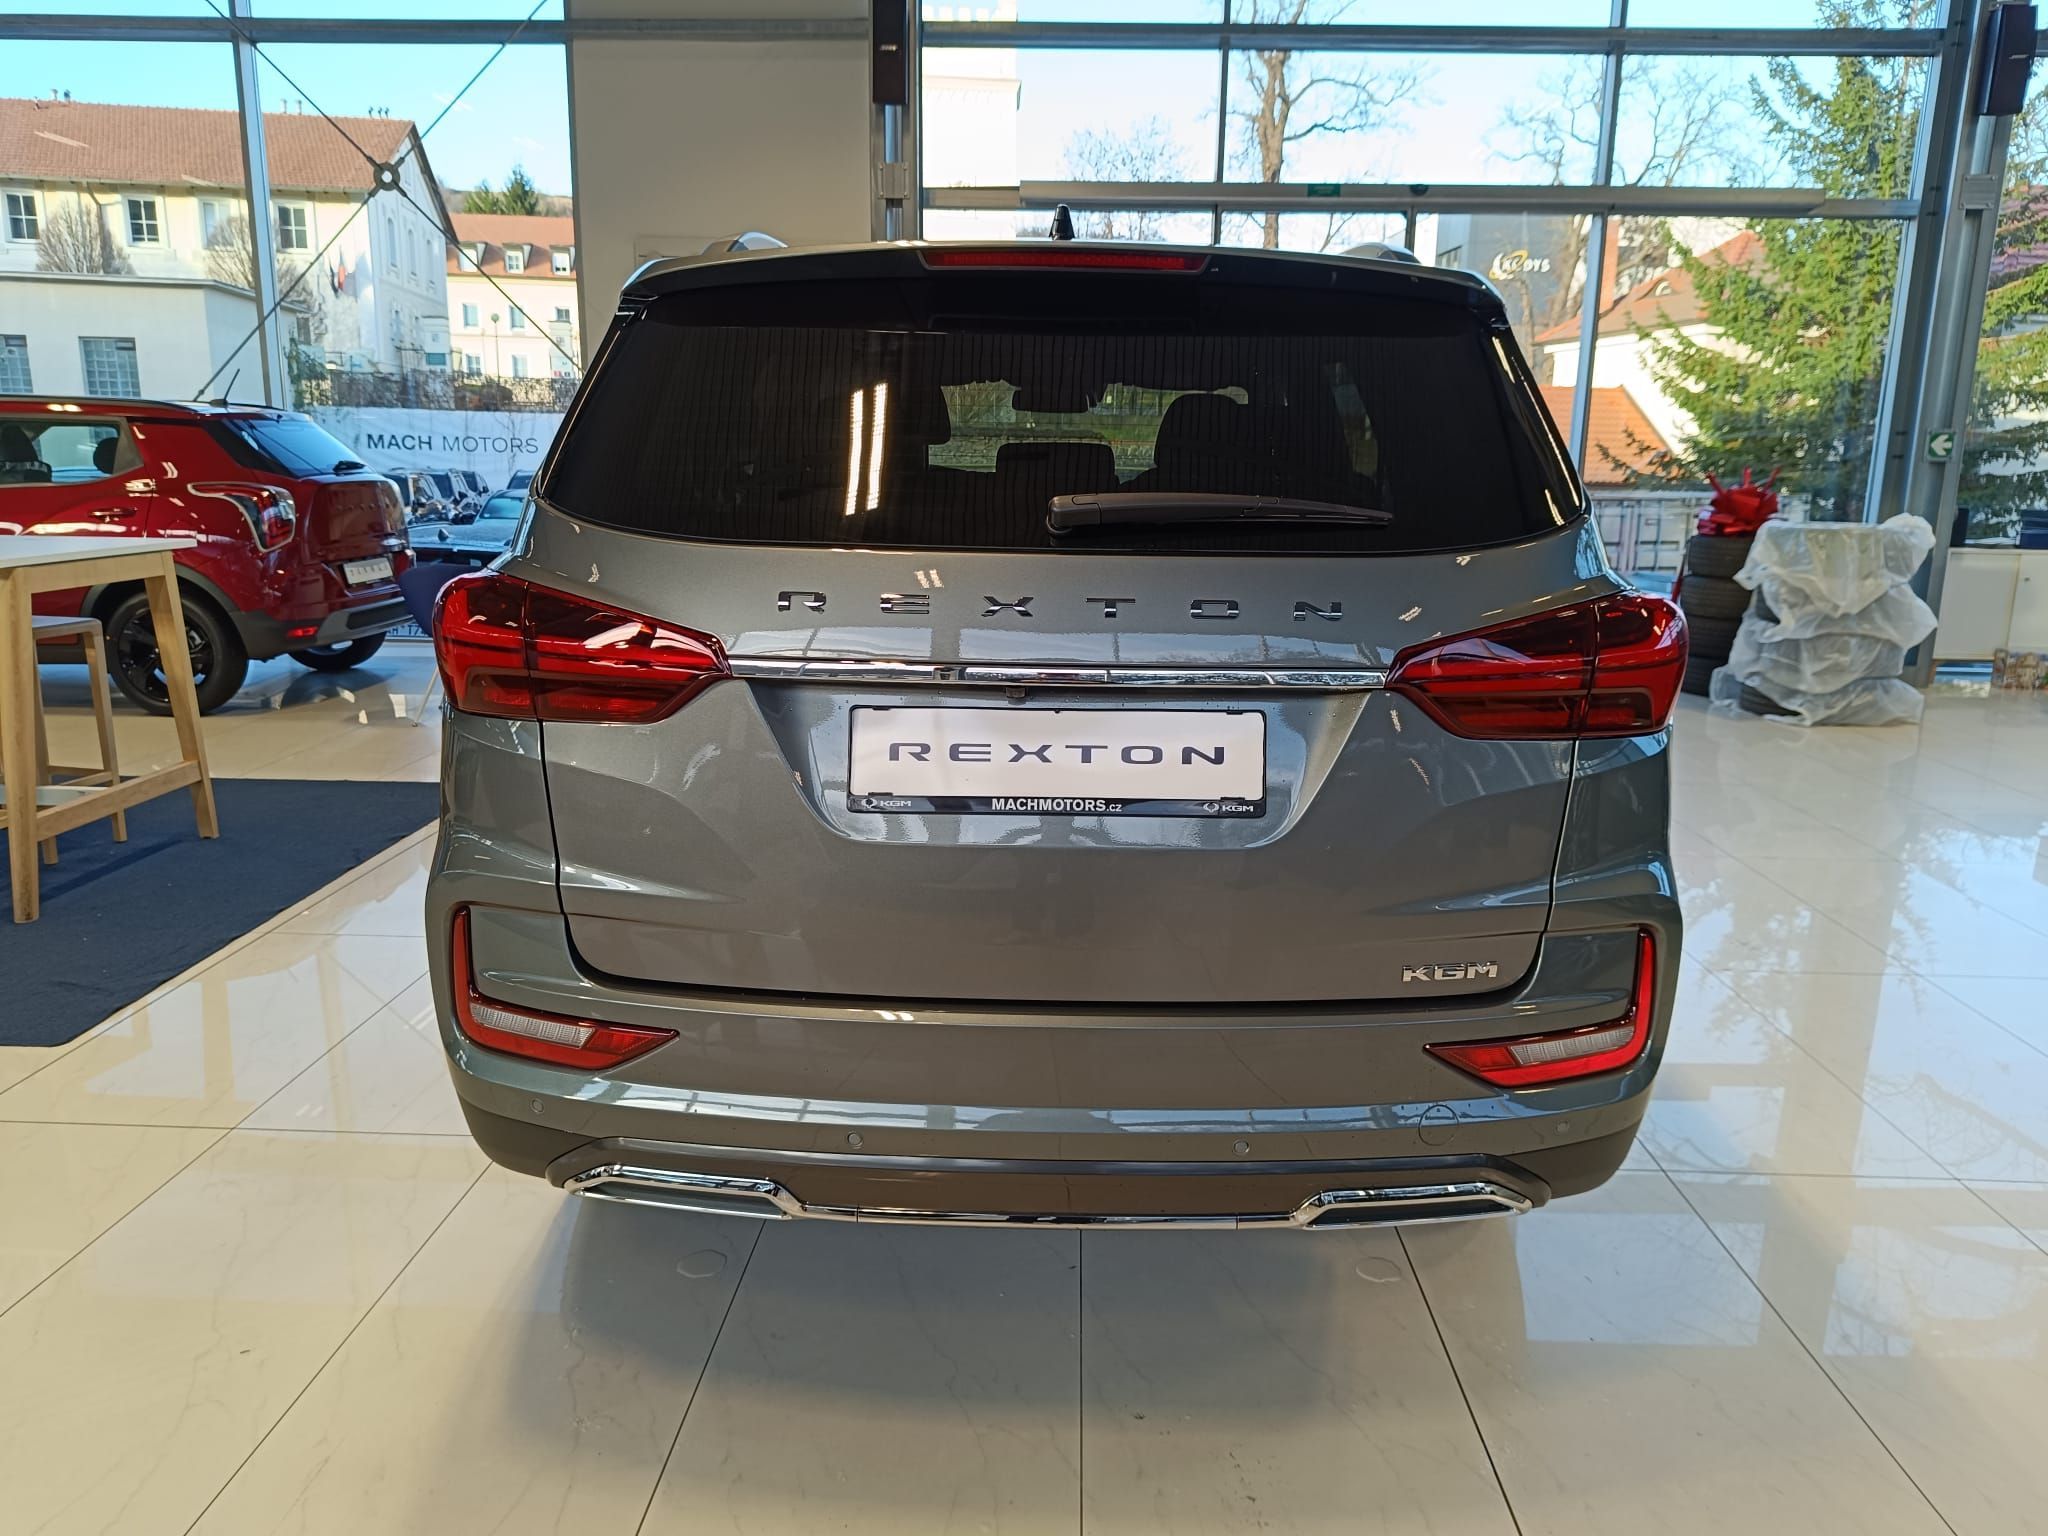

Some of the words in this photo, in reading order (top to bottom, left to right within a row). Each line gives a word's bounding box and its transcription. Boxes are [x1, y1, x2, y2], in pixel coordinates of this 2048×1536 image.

[367, 433, 432, 450] MACH
[443, 436, 539, 454] MOTORS
[777, 590, 1342, 621] REXTON
[889, 742, 1225, 765] REXTON
[991, 798, 1122, 812] MACHMOTORS.cz
[1402, 961, 1498, 982] KGM
